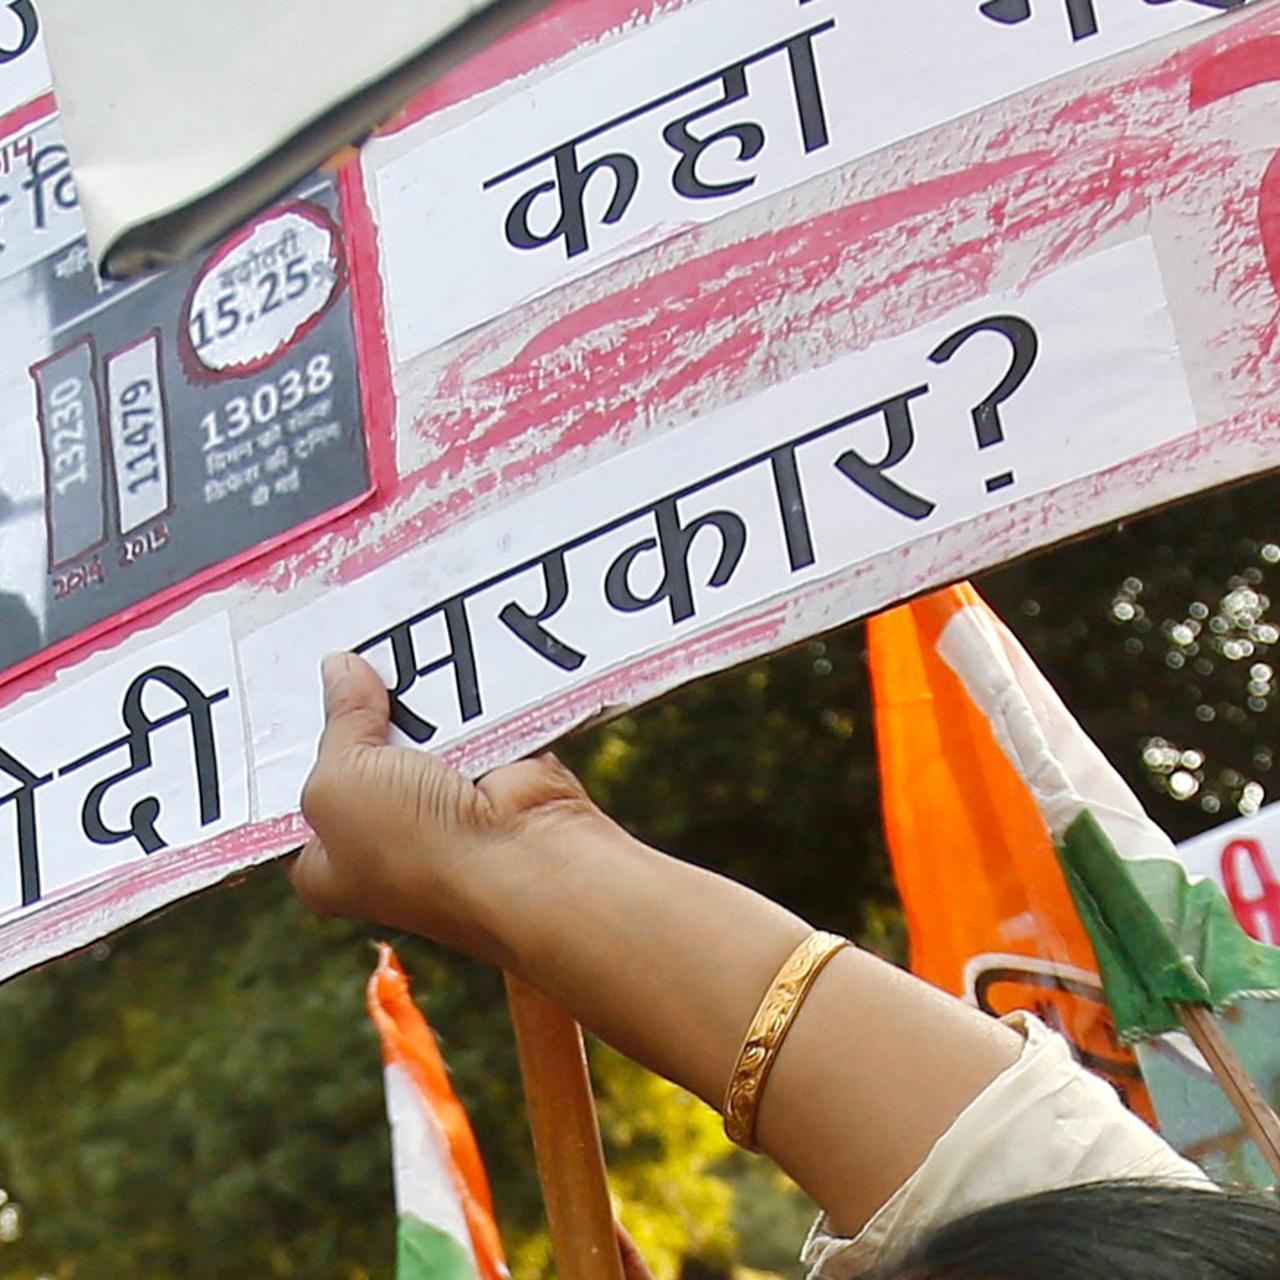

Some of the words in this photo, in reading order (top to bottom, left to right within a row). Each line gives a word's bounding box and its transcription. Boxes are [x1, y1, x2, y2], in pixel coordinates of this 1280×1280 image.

[52, 377, 88, 496] 13230
[120, 378, 160, 494] 11479
[200, 353, 334, 451] 13038
[348, 314, 1040, 744] सरकार?
